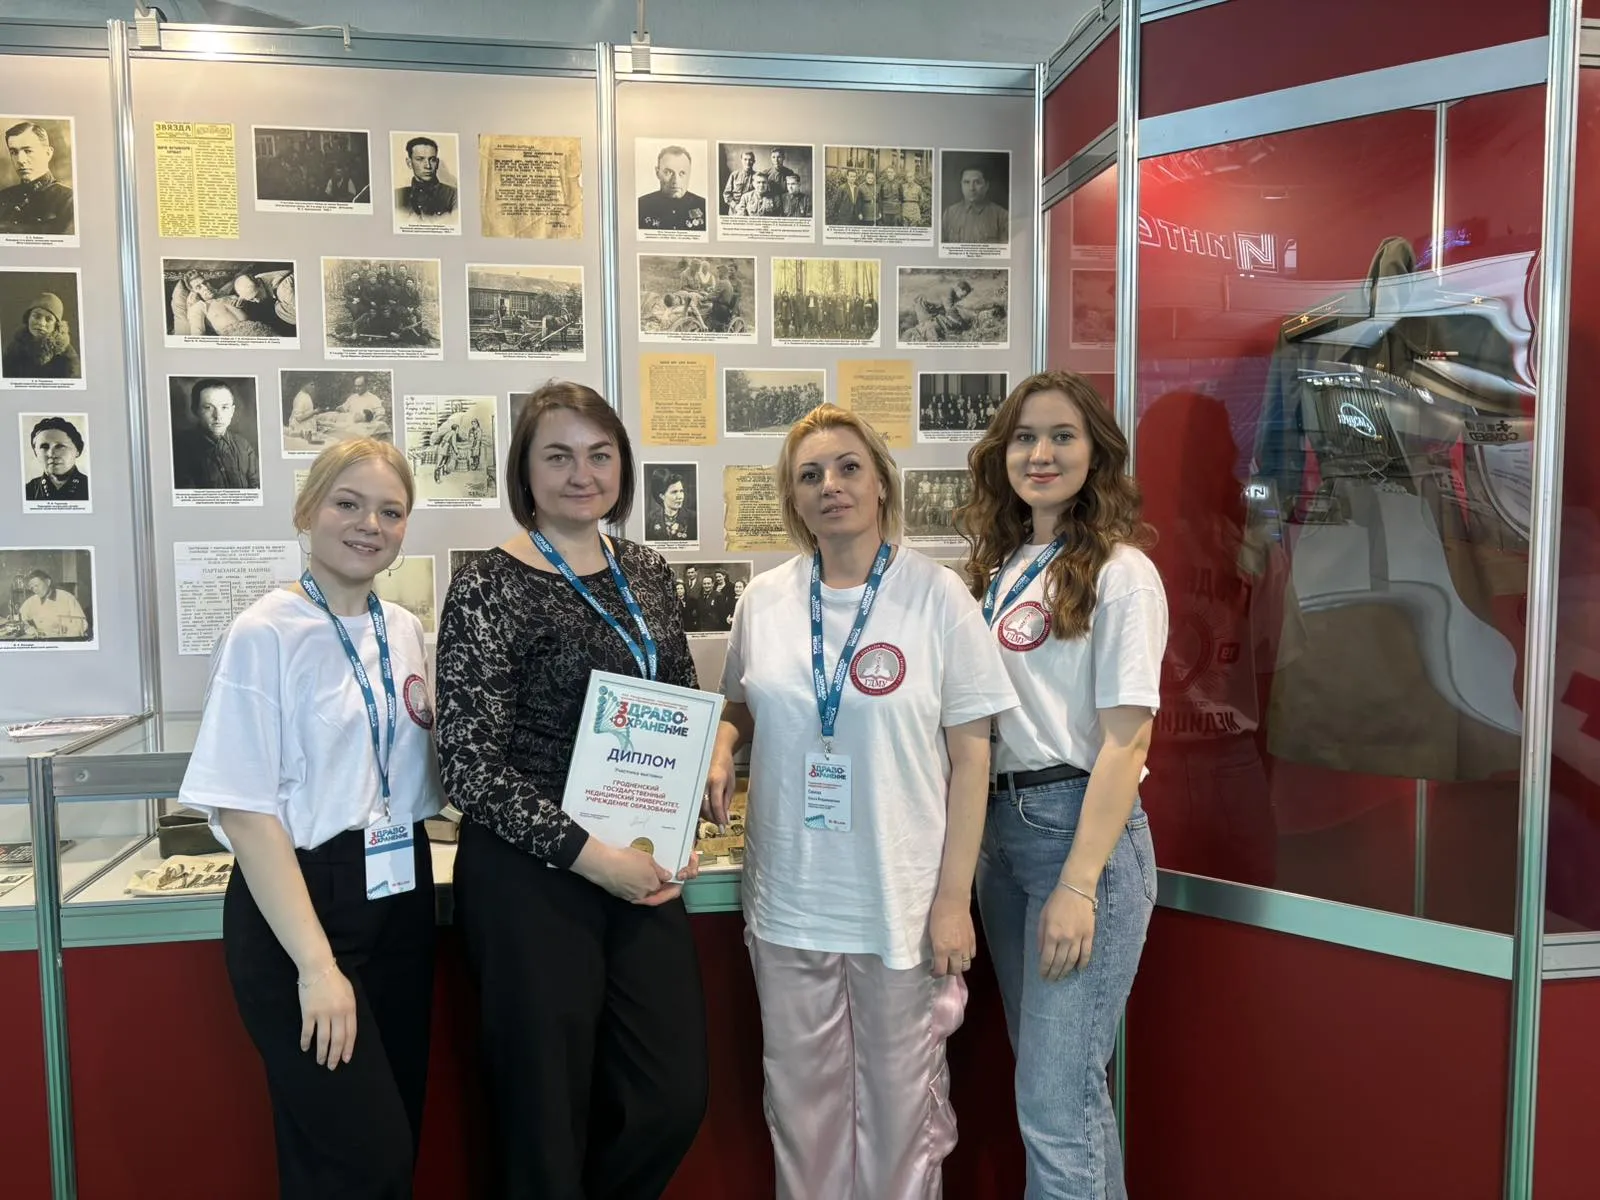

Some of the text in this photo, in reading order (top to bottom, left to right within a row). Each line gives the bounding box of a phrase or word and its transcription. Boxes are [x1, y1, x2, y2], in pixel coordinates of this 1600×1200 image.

[156, 124, 191, 132] ЗВЯЗДА
[535, 531, 553, 553] ЗДРАВО
[877, 558, 886, 576] MEDICA
[861, 586, 872, 608] ЗДРАВО
[372, 612, 381, 637] ЗДРАВО
[356, 662, 368, 689] ЗДРАВО
[865, 679, 888, 688] ГДМУ
[818, 674, 827, 700] ЗДРАВО
[618, 701, 684, 724] ЗДРАВО
[614, 714, 688, 736] ОХРАНЕНИЕ
[606, 748, 676, 770] ДИПЛОМ
[812, 764, 844, 774] ЗДРАВО
[603, 785, 666, 798] ГОСУДАРСТВЕННЫЙ
[612, 780, 660, 790] ГРОДНЕНСКИЙ
[585, 789, 635, 801] МЕДИЦИНСКИЙ
[585, 796, 677, 814] УЧРЕЖДЕНИЕ ОБРАЗОВАНИЯ
[372, 826, 406, 838] ЗДРАВО
